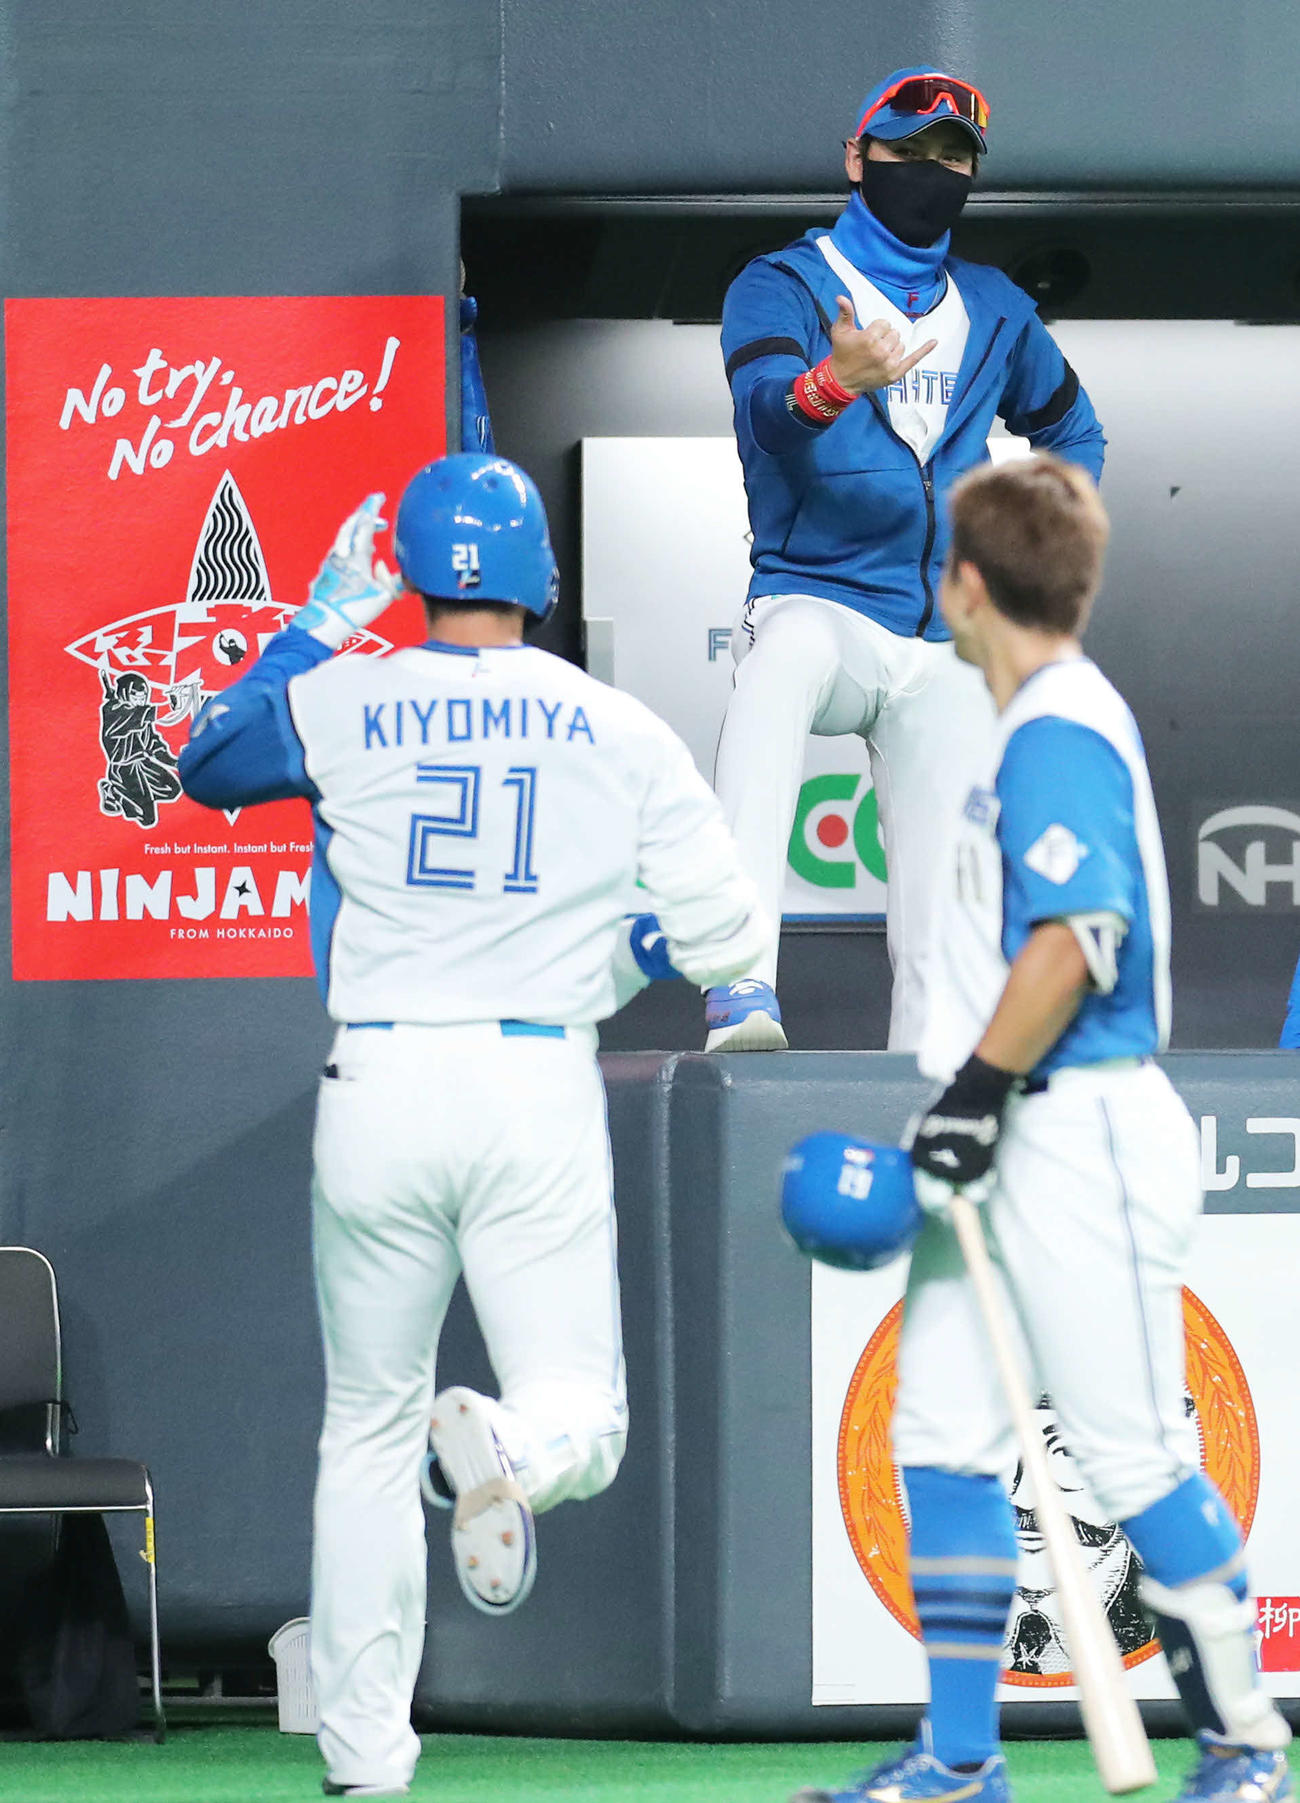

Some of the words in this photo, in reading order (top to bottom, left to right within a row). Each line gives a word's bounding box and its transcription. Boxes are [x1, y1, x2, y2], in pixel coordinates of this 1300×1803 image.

[59, 363, 126, 431] No
[107, 415, 174, 481] No
[451, 544, 480, 571] 21
[364, 698, 596, 750] KIYOMIYA
[144, 842, 171, 855] Fresh
[174, 842, 191, 854] but
[194, 842, 231, 854] Instant.
[234, 842, 268, 853] Instant
[270, 841, 287, 853] but
[406, 763, 538, 893] 21
[46, 866, 313, 922] NINJAM
[170, 928, 209, 939] FROM
[217, 927, 294, 939] HOKKAIDO
